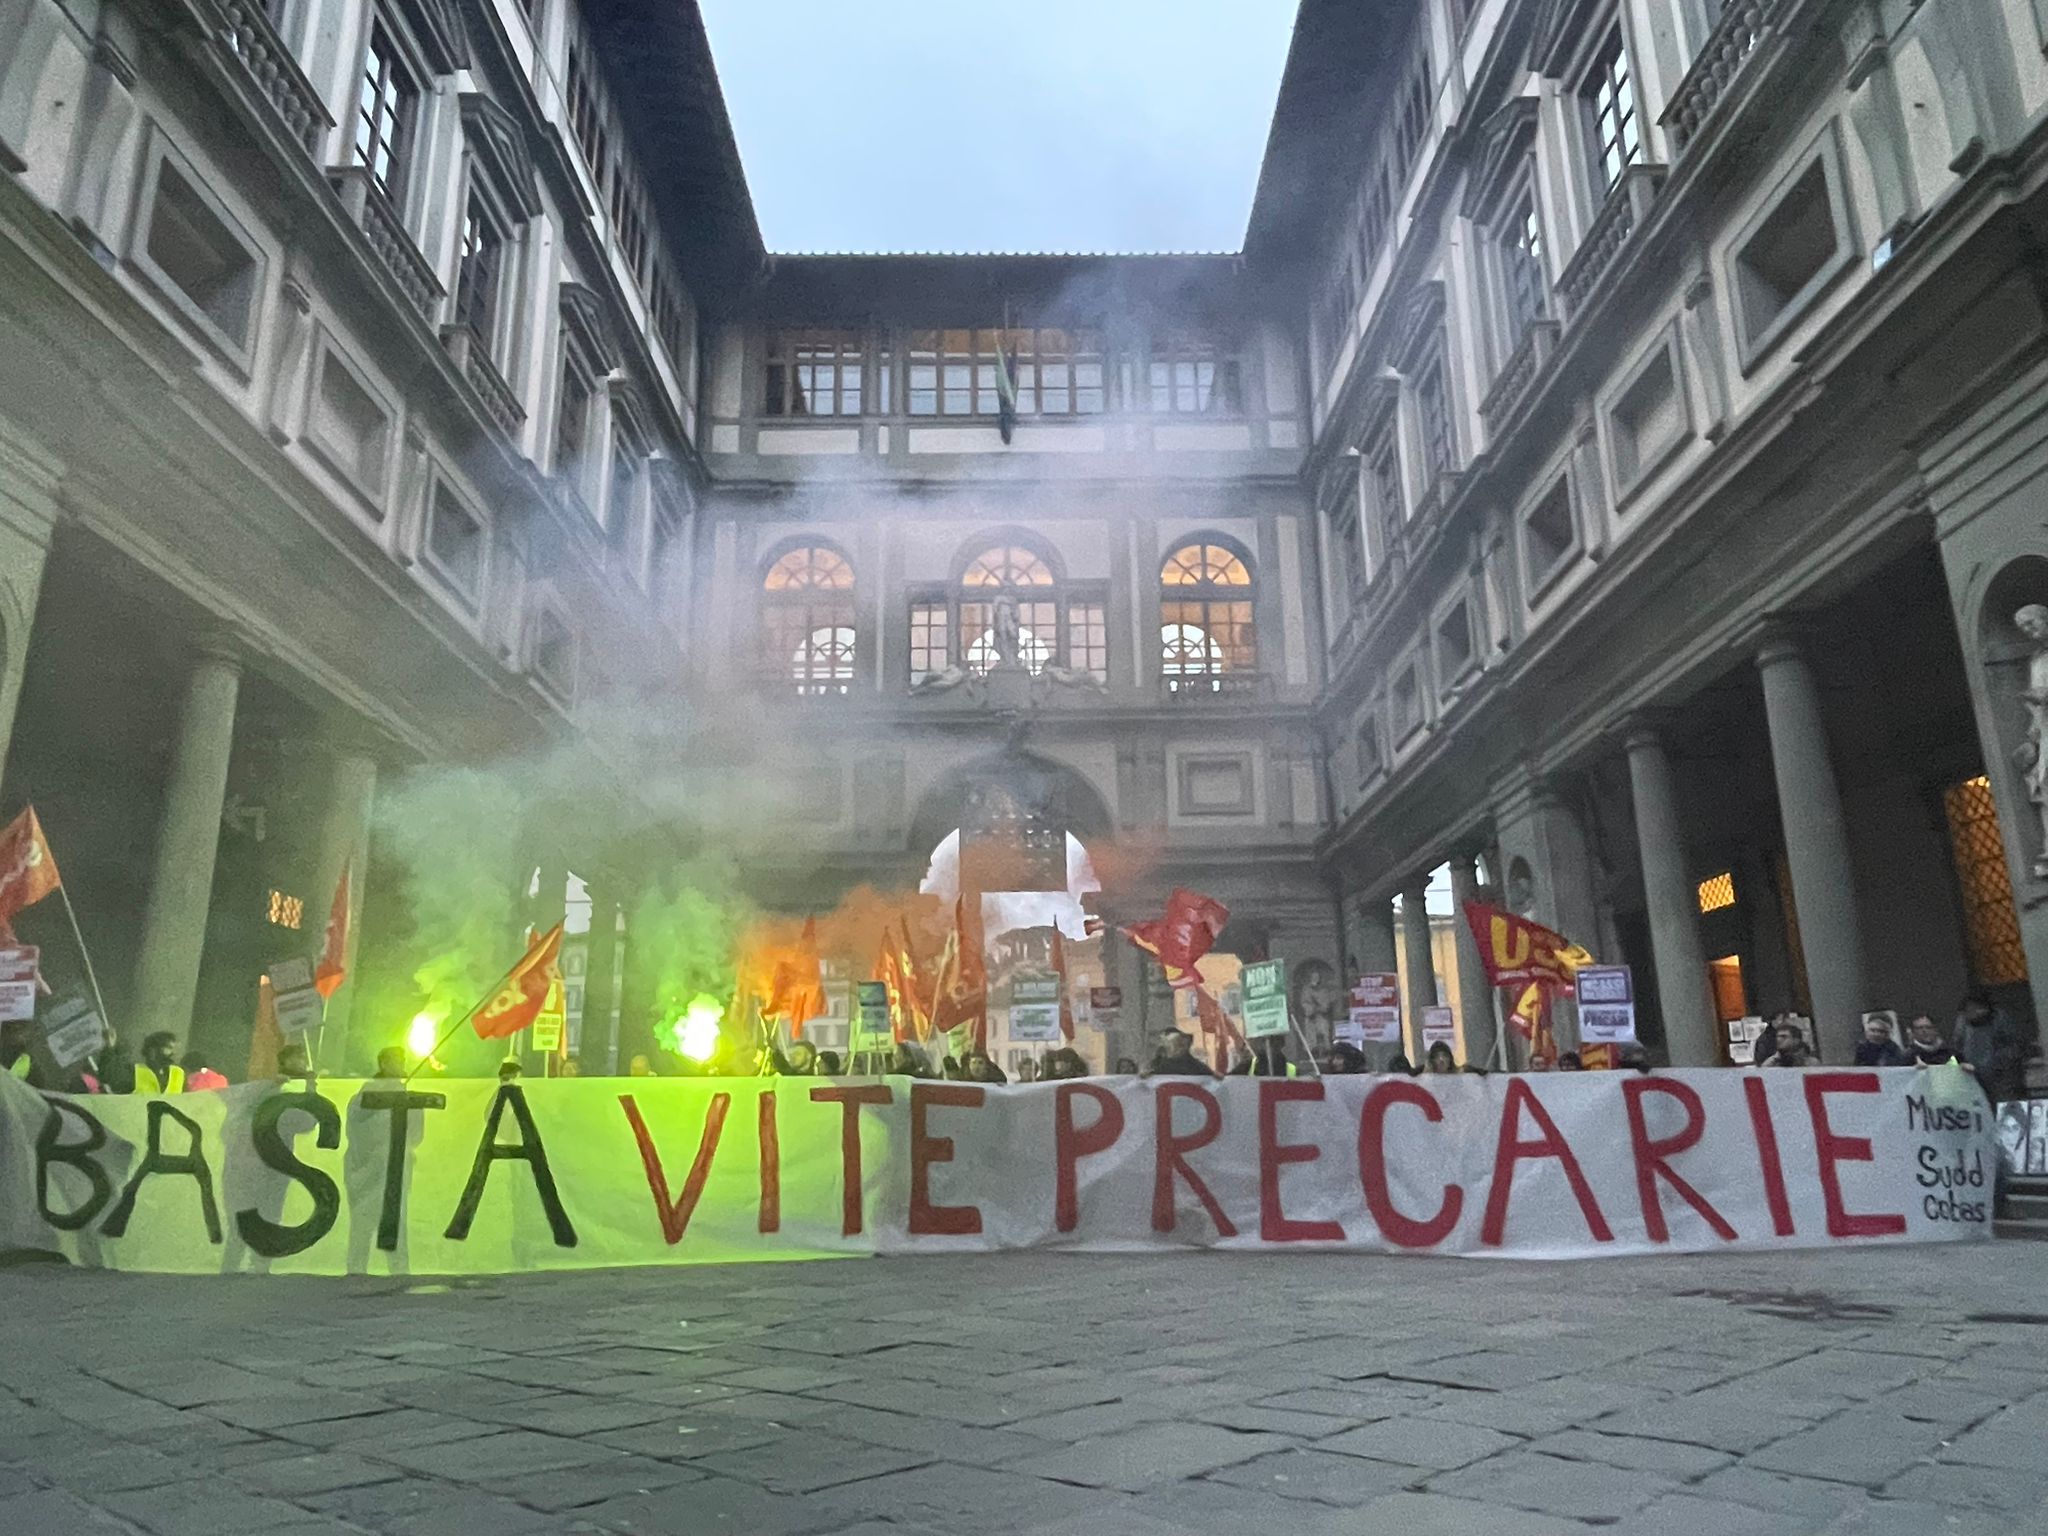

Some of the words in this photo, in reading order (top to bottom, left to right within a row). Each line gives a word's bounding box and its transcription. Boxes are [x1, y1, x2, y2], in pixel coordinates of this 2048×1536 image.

[1905, 1094, 1982, 1132] Musei
[37, 1085, 578, 1258] BASTA
[618, 1084, 985, 1245] VITE
[1054, 1073, 1906, 1247] PRECARIE
[1916, 1145, 1984, 1188] Sudd
